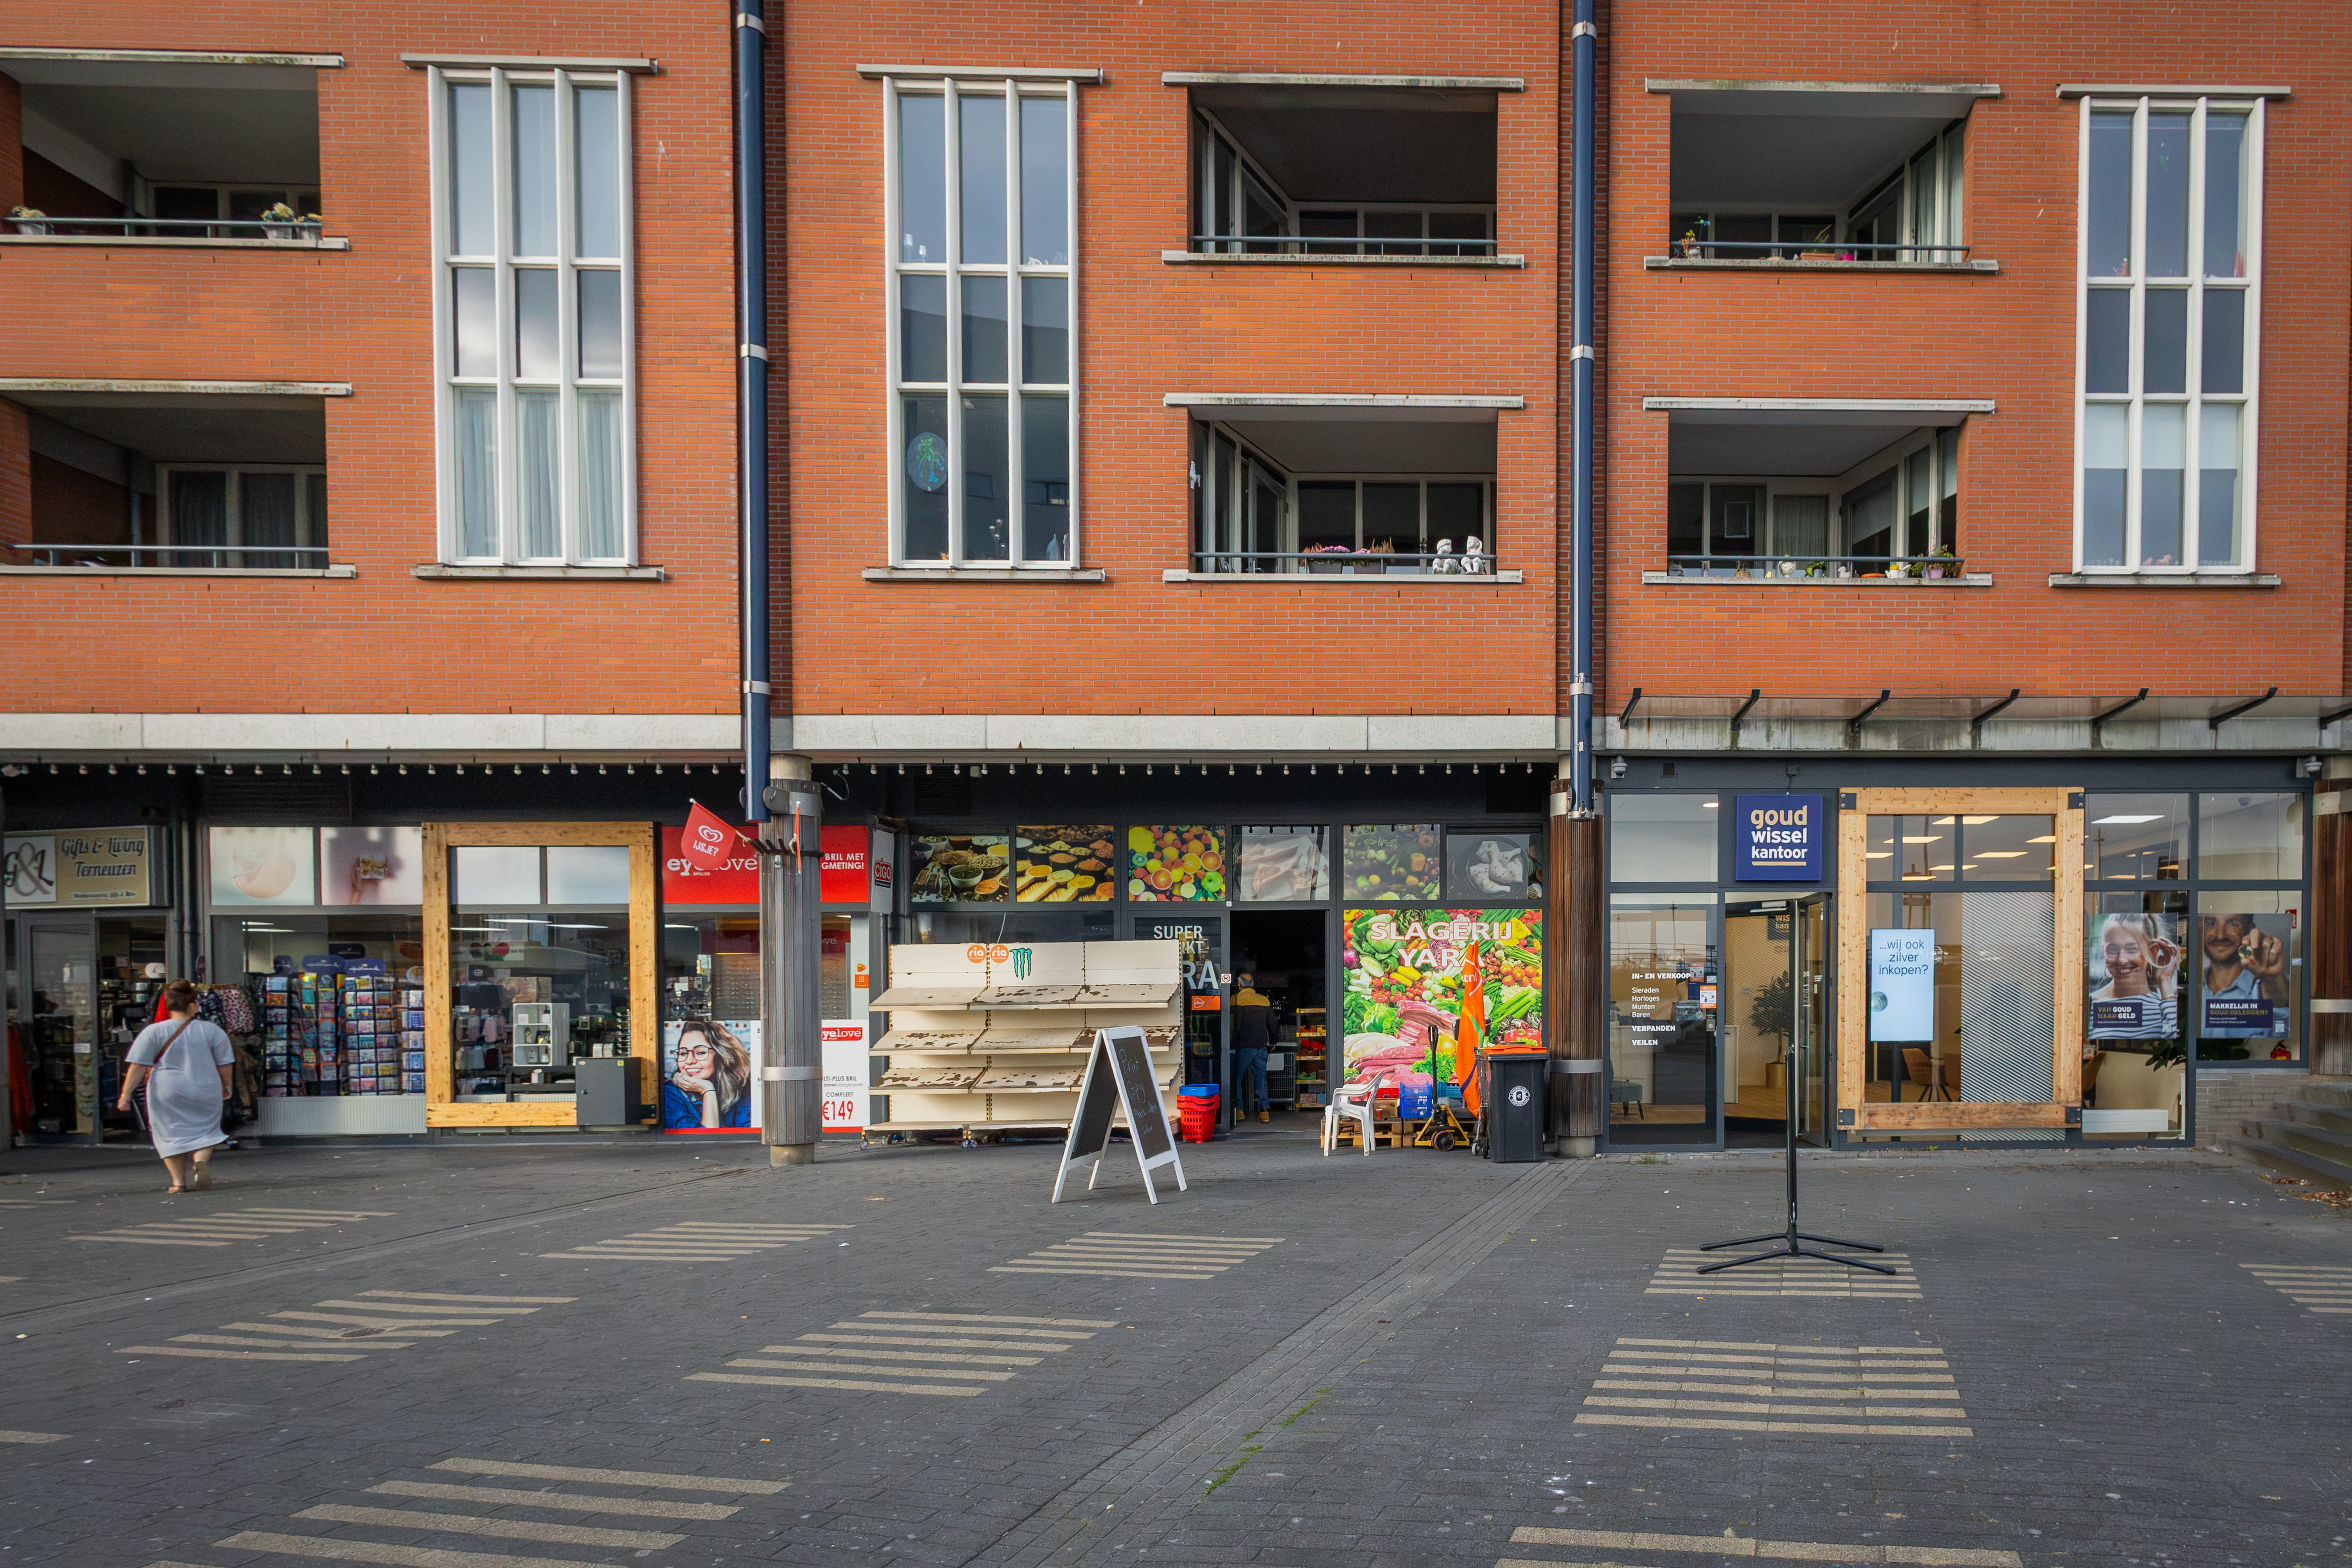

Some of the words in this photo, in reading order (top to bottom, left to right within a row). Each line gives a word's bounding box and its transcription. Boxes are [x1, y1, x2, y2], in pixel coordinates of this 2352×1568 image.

[1751, 805, 1807, 829] goud
[1751, 826, 1807, 843] wissel
[61, 838, 89, 859] Gifts
[108, 837, 144, 857] Living
[693, 840, 719, 857] IJSJE?
[1751, 845, 1808, 859] kantoor
[75, 861, 136, 877] Terneuzen
[875, 864, 891, 880] CIGO
[1154, 925, 1203, 939] SUPER
[1370, 921, 1512, 941] SLAGERIJ
[969, 947, 984, 957] ria
[992, 947, 1007, 957] ria
[1880, 939, 1902, 952] ...wij
[1905, 939, 1925, 949] ook
[1889, 952, 1918, 962] zilver
[1879, 964, 1928, 977] inkopen?
[1119, 1049, 1139, 1075] Print
[822, 1101, 854, 1121] €149
